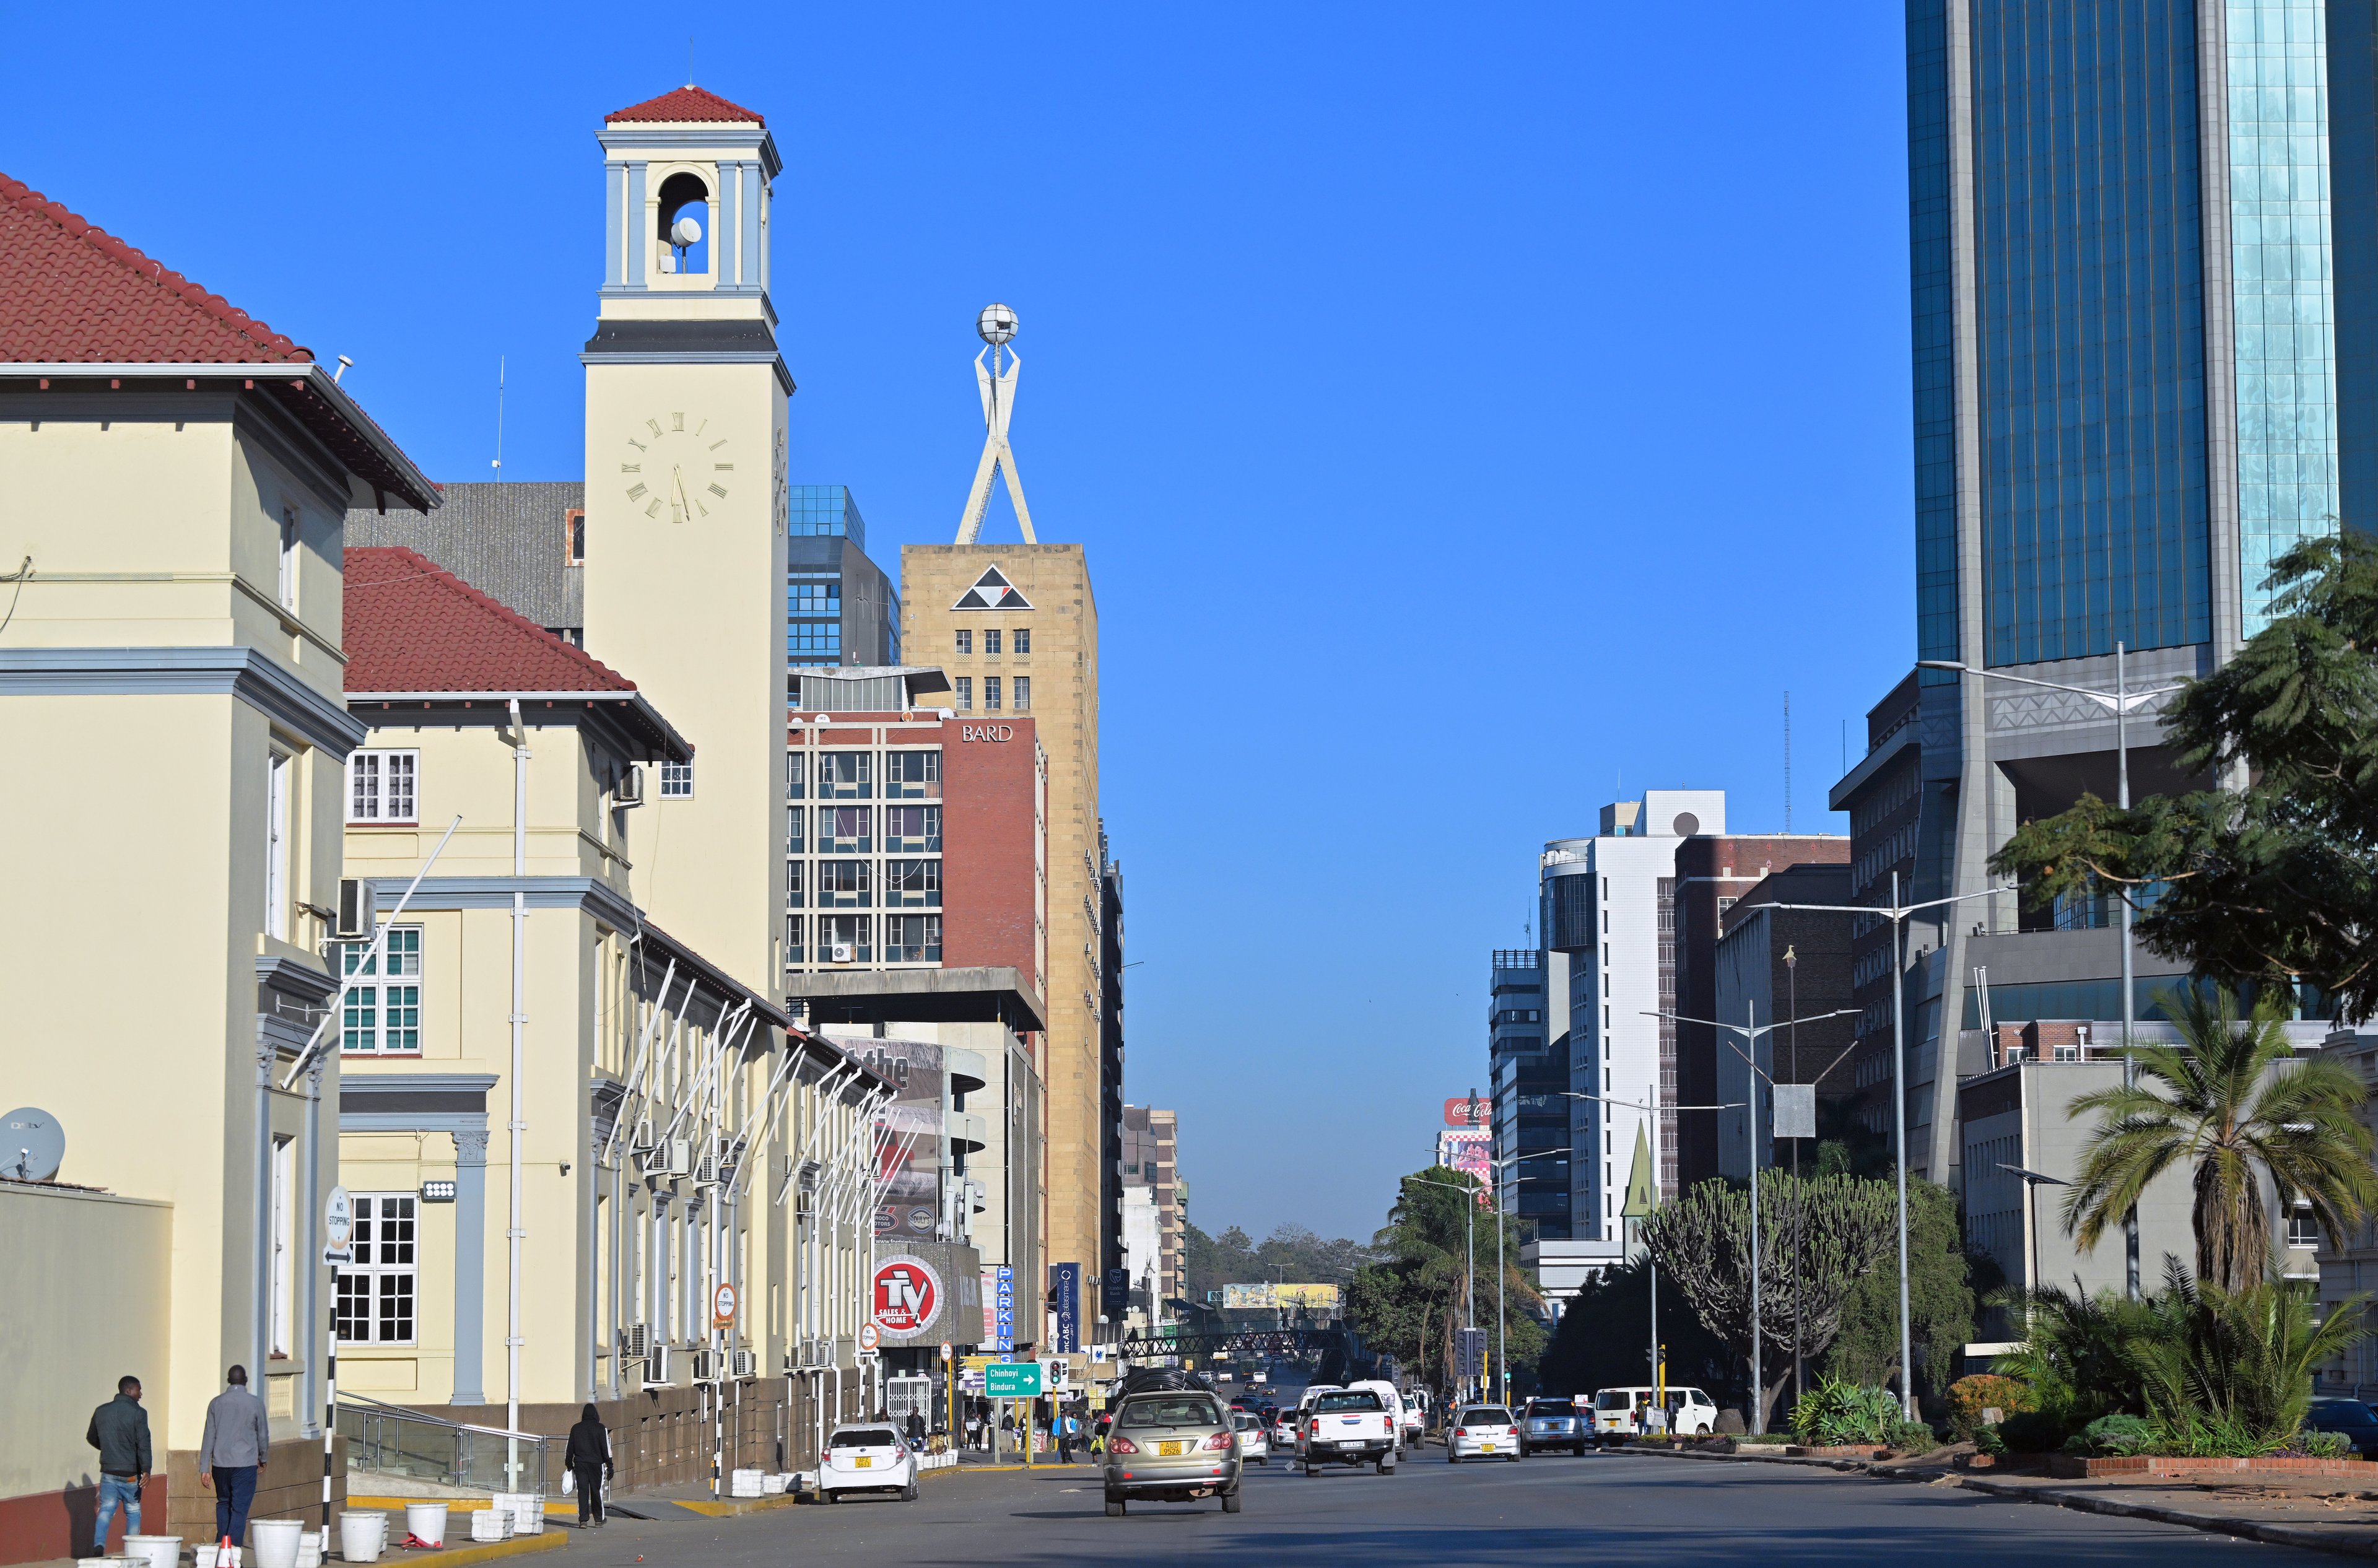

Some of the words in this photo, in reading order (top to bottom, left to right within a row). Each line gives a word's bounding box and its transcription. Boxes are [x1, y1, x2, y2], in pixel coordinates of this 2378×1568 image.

[962, 725, 1013, 742] BARD
[336, 1203, 343, 1211] NO
[329, 1216, 349, 1226] STOPPING
[913, 1216, 930, 1224] DULY'S
[875, 1255, 908, 1270] ANTEED
[879, 1270, 929, 1317] TV
[1061, 1280, 1069, 1312] atlasmara
[907, 1297, 943, 1338] APPLIANCES
[998, 1269, 1011, 1363] PARKING
[991, 1369, 1018, 1379] Chinhoyi
[991, 1382, 1016, 1390] Bindura
